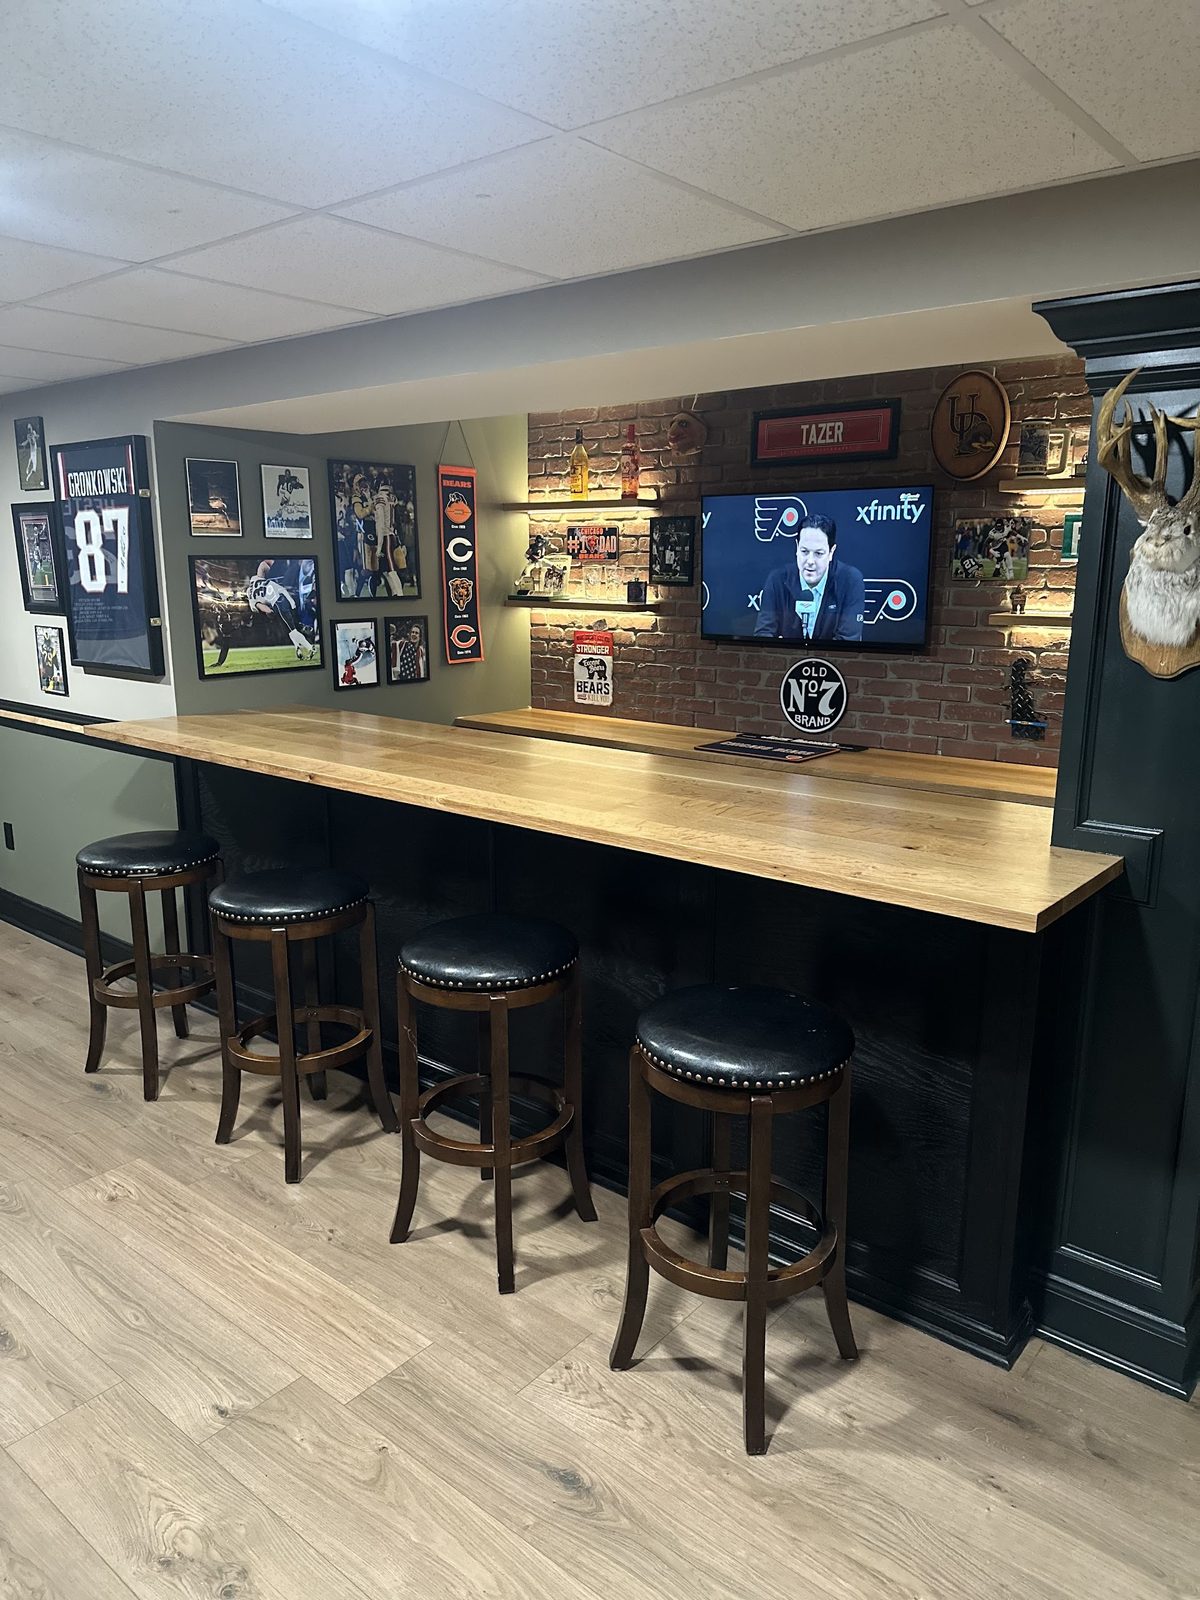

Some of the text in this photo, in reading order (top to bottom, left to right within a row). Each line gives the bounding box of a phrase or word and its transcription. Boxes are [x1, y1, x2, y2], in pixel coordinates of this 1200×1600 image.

[801, 421, 844, 445] TAZER
[67, 466, 127, 498] GRONKOWSKI
[443, 480, 472, 488] BEARS
[855, 498, 926, 525] xfinity
[580, 527, 604, 535] CHICAGO
[74, 506, 129, 594] 87
[446, 537, 473, 562] C
[599, 535, 617, 553] DAD
[450, 624, 477, 648] C
[576, 644, 610, 655] STRONGER
[802, 666, 828, 677] OLD
[576, 680, 610, 695] BEARS
[794, 714, 831, 727] BRAND
